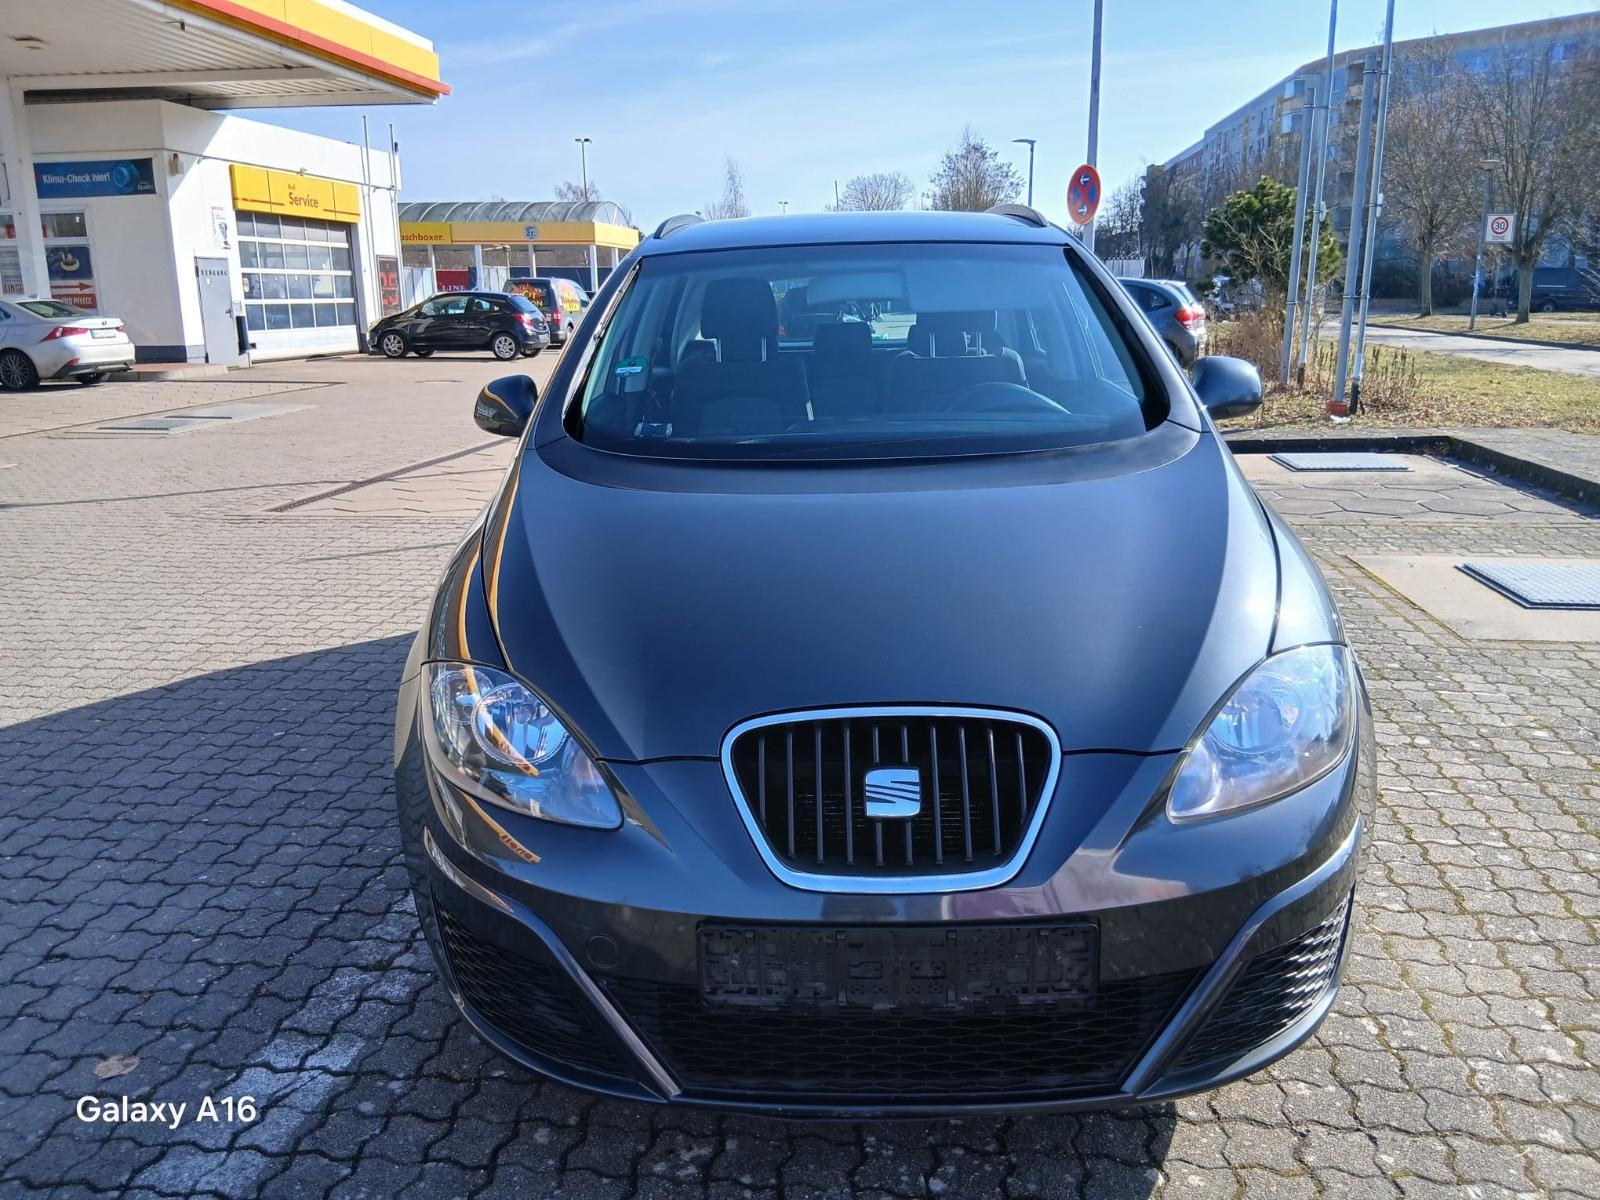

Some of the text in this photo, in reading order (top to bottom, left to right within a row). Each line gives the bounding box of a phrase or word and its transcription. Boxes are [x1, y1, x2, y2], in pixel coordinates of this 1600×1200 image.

[42, 173, 110, 184] Klima-Check hier!
[288, 191, 318, 208] Service
[1495, 221, 1505, 230] 30
